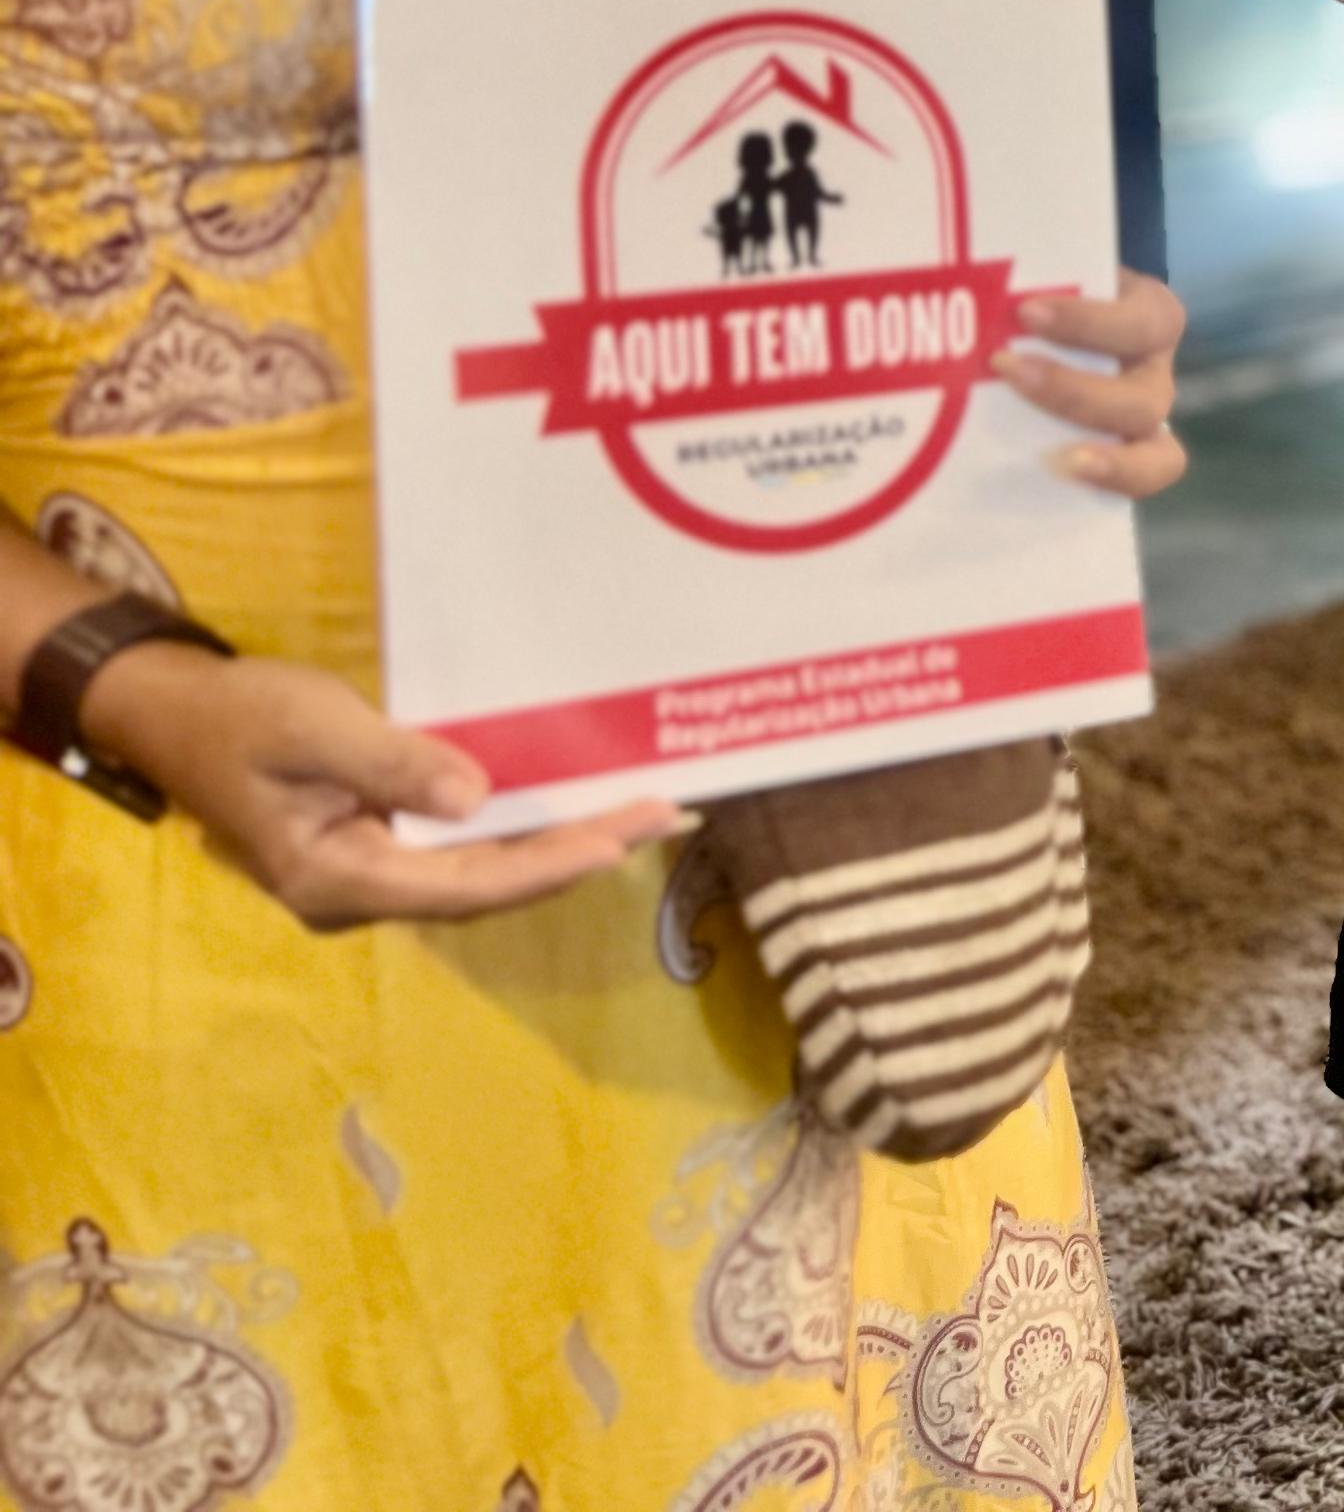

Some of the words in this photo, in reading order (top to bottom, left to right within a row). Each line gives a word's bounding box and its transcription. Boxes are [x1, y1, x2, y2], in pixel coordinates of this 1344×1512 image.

[586, 316, 711, 409] AQUI
[721, 301, 831, 387] TEM
[843, 287, 978, 372] DONO
[676, 414, 905, 465] REGULARIZAÇÃO
[746, 447, 859, 480] URBANA
